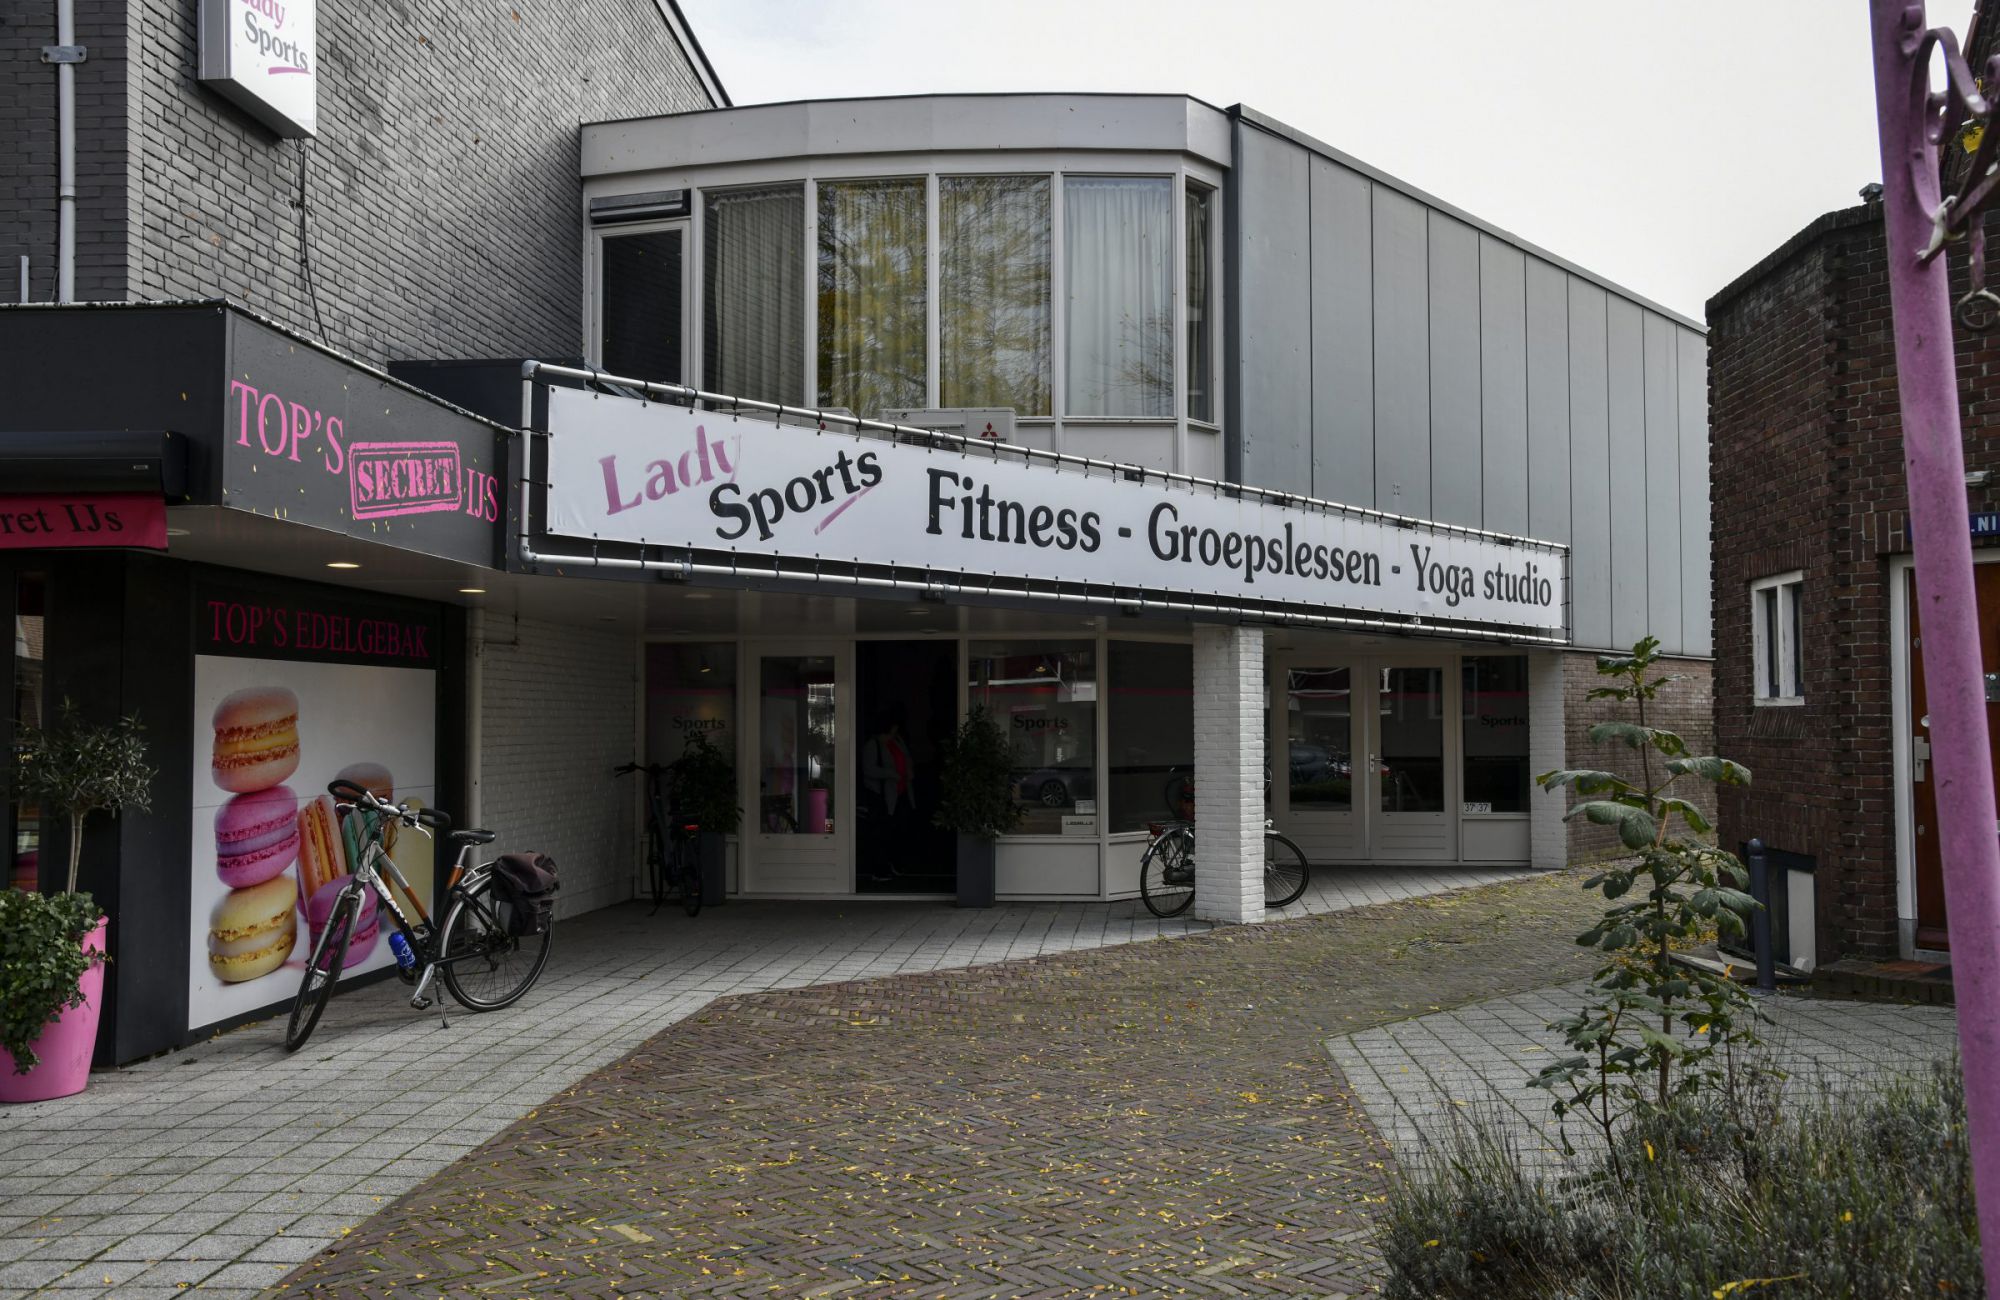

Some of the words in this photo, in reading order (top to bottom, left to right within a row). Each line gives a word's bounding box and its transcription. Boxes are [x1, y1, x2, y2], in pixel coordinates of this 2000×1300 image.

[245, 10, 309, 73] Sports
[357, 457, 454, 503] SECRET
[466, 468, 498, 522] IJS
[598, 424, 742, 516] Lady
[709, 449, 883, 541] Sports
[61, 503, 124, 533] IJs
[925, 467, 1101, 553] Fitness
[1148, 501, 1381, 584] Groepslessen
[1410, 543, 1475, 607] Yoga
[1483, 561, 1552, 607] studio
[208, 601, 289, 648] TOP'S
[295, 610, 429, 658] EDELGEBAK
[671, 715, 726, 731] Sports
[1013, 714, 1069, 731] Sports
[1480, 714, 1526, 728] Sports
